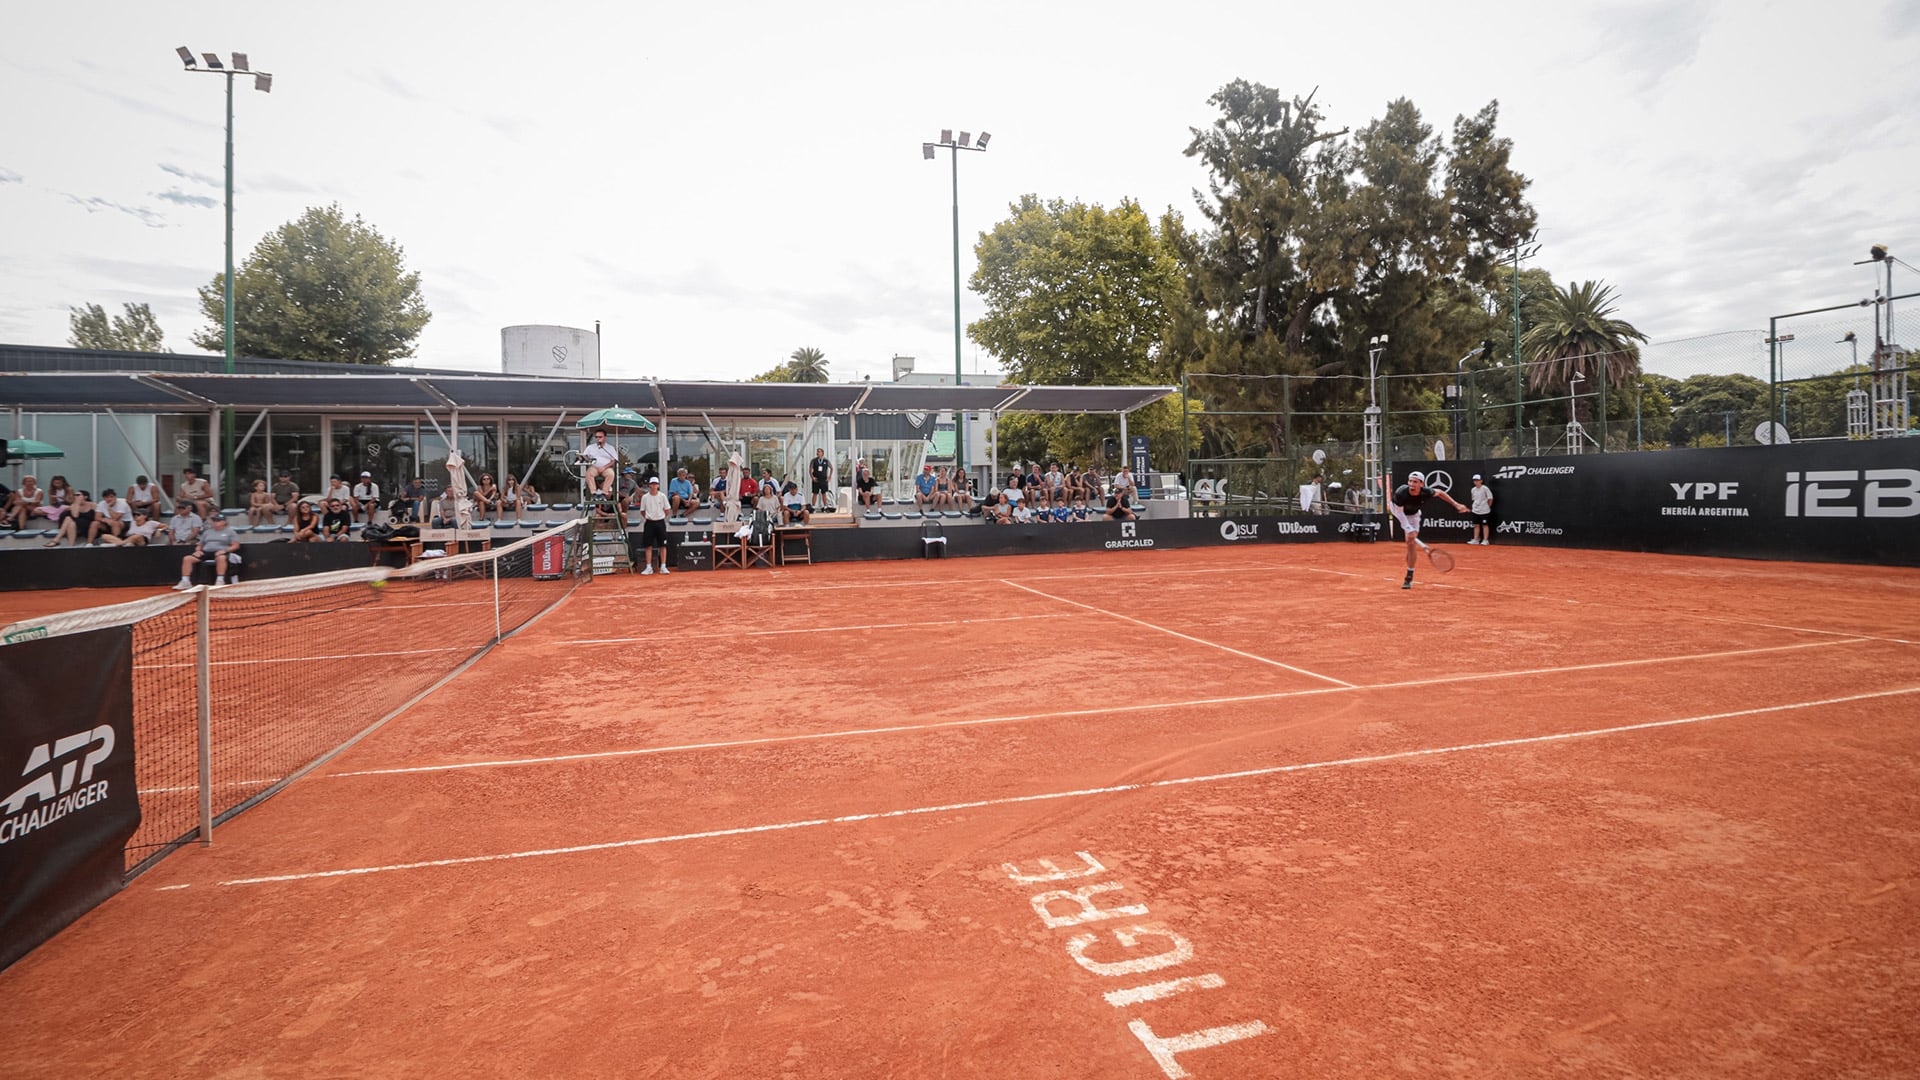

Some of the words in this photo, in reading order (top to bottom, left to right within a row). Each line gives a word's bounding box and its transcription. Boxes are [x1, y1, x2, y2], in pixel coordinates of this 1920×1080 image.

[1493, 465, 1527, 479] ATP
[1527, 466, 1575, 475] CHALLENGER
[1669, 482, 1739, 500] YPF
[1661, 505, 1697, 516] ENERGÍA
[1698, 507, 1749, 517] ARGENTINA
[1277, 521, 1319, 534] Wilson
[1525, 527, 1563, 535] ARGENTINO
[1105, 539, 1154, 549] GRAFICALED
[542, 541, 551, 571] Wilson
[0, 724, 115, 815] ATP
[0, 780, 109, 844] CHALLENGER
[1002, 850, 1275, 1080] TIGRE
